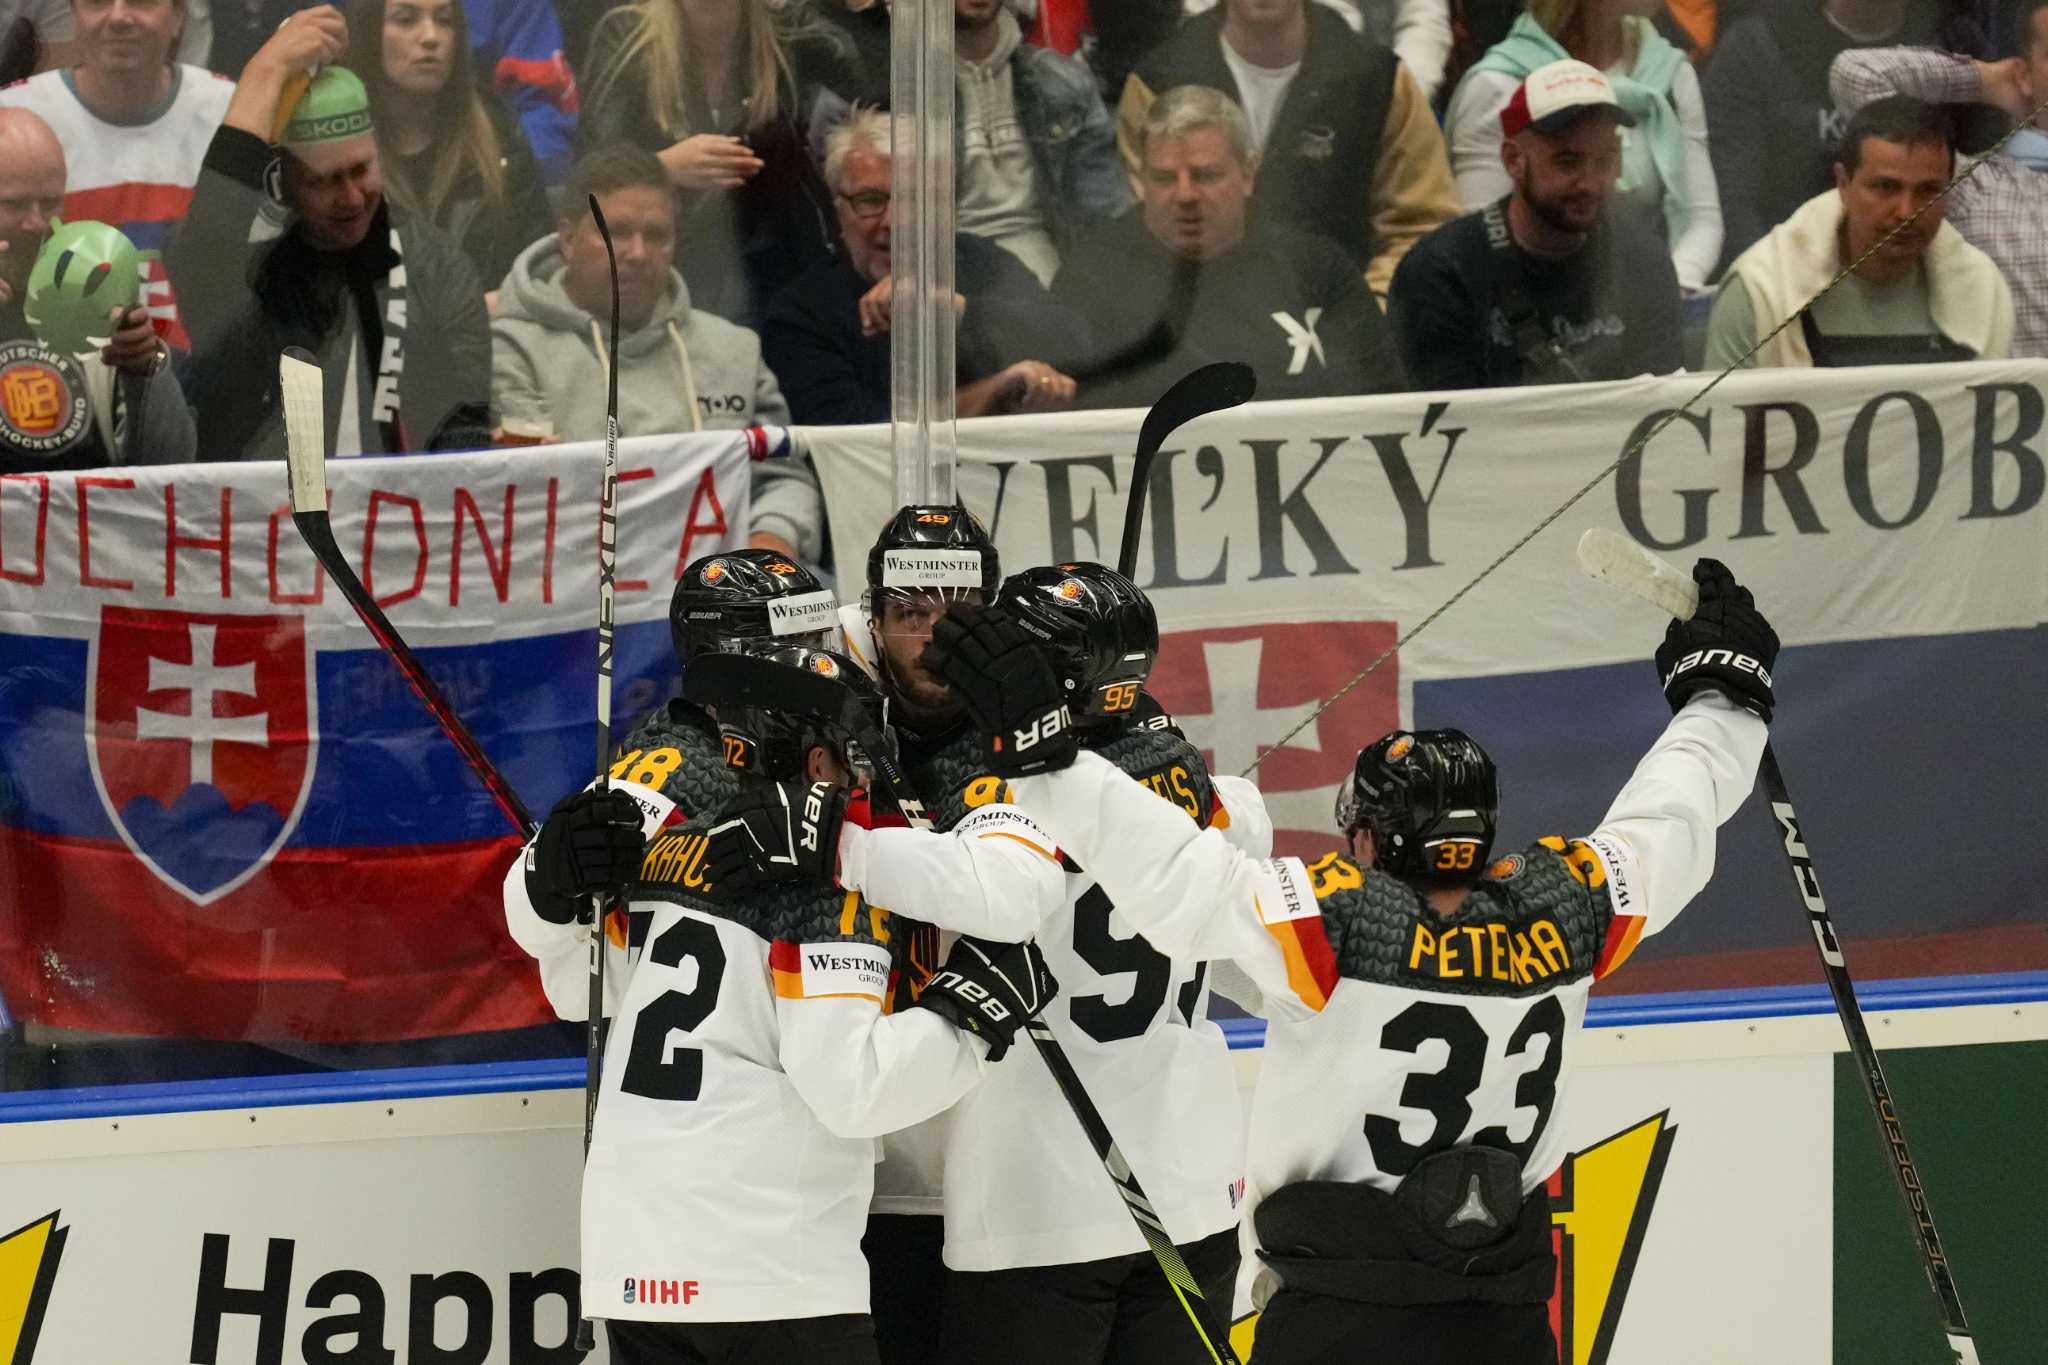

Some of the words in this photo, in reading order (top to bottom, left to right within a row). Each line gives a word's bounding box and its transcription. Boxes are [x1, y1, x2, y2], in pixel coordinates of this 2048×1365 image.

[1615, 381, 2046, 551] GROB
[916, 513, 950, 524] 49
[599, 475, 617, 677] NEXUS
[764, 562, 797, 575] 38
[886, 557, 978, 571] WESTMINSTER
[1103, 684, 1138, 712] 95
[723, 736, 746, 768] 72
[640, 834, 713, 892] KAHU
[1436, 843, 1476, 869] 33
[1771, 801, 1845, 967] CCM
[1363, 994, 1566, 1176] 33
[1880, 1098, 1945, 1273] JETSPEED
[639, 1279, 699, 1304] IIHF
